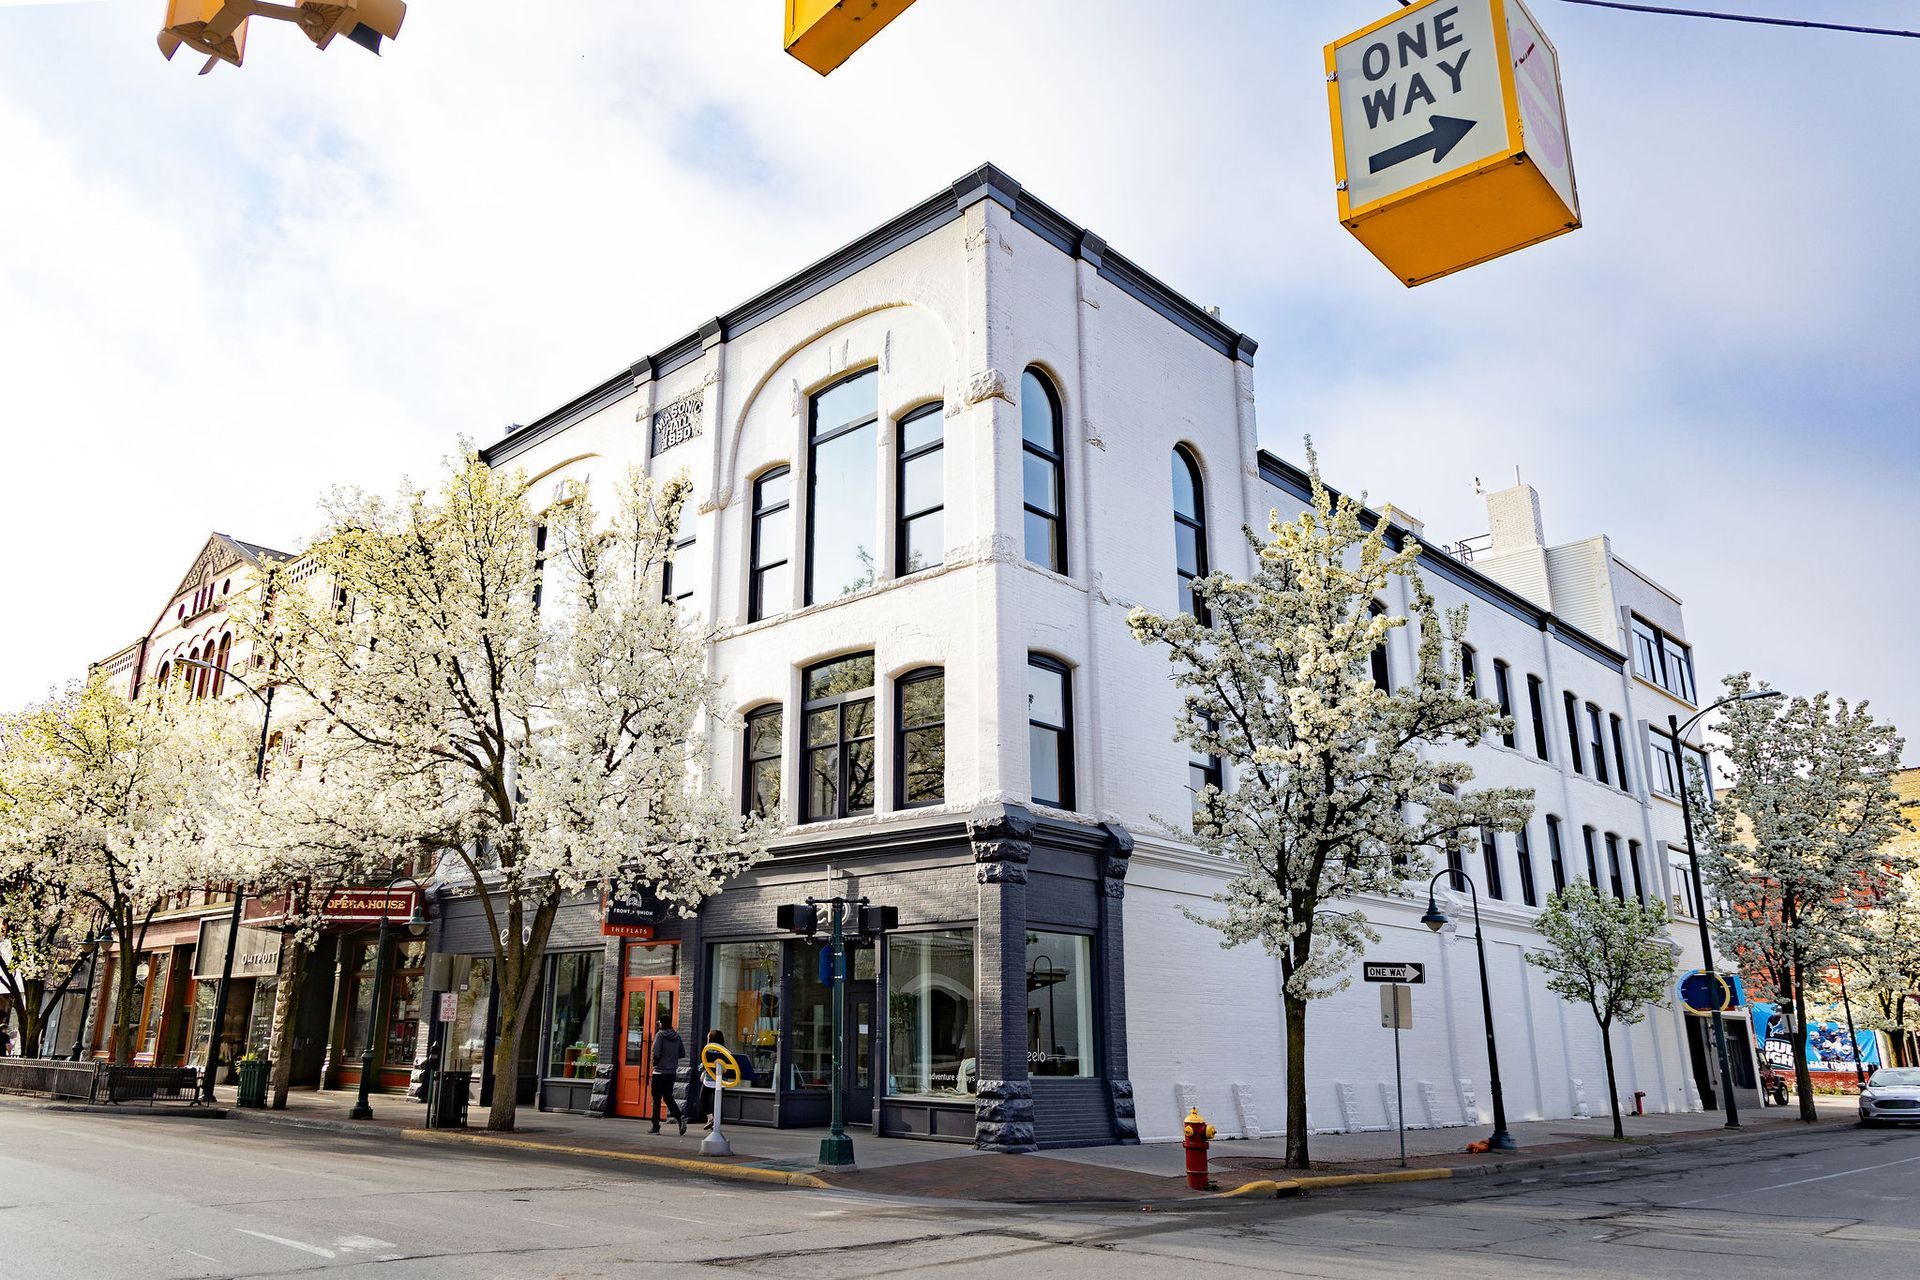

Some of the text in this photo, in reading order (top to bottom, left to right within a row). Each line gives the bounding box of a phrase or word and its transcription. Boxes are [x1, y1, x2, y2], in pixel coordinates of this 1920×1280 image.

[1362, 5, 1463, 81] ONE
[1361, 48, 1471, 130] WAY
[656, 399, 702, 433] MASONIC
[664, 416, 690, 436] HALL
[367, 899, 406, 910] HOUSE
[241, 951, 278, 965] OUTPOST
[1369, 968, 1406, 977] ONE WAY
